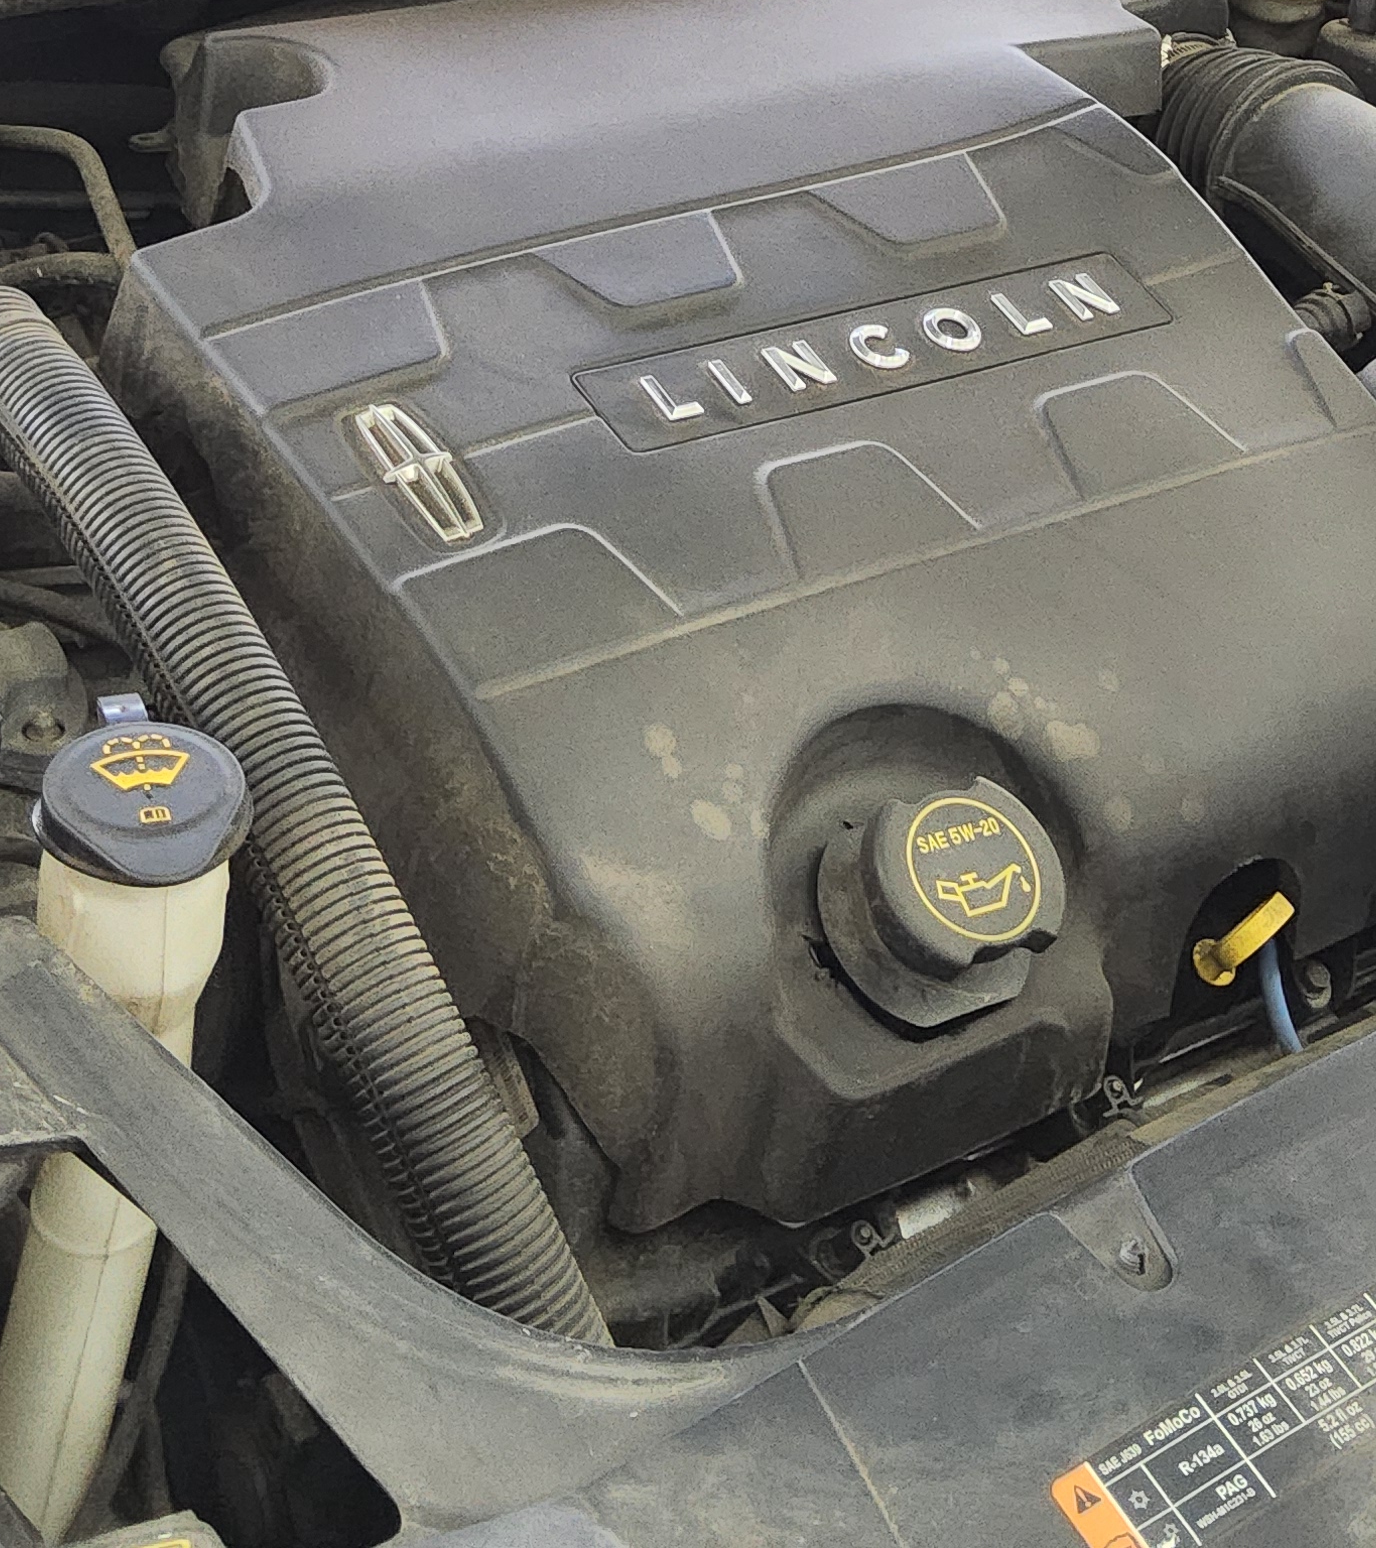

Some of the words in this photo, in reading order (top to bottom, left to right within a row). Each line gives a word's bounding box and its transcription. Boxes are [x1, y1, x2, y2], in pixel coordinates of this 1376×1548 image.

[639, 272, 1121, 422] LINCOLN
[916, 831, 950, 854] SAE
[948, 817, 1001, 845] 5W-20
[1341, 1333, 1373, 1357] 0.822
[1361, 1348, 1376, 1363] 29
[1285, 1368, 1317, 1391] 0.652
[1316, 1359, 1334, 1374] kg
[1305, 1383, 1320, 1398] 23
[1319, 1377, 1333, 1389] oz
[1227, 1400, 1258, 1426] 0.737
[1257, 1393, 1277, 1408] kg
[1311, 1394, 1332, 1412] 1.44
[1329, 1386, 1346, 1400] lbs
[1248, 1417, 1263, 1433] 26
[1262, 1412, 1276, 1423] oz
[1318, 1409, 1339, 1432] 5.2
[1346, 1401, 1363, 1414] oz
[1329, 1425, 1357, 1449] (155
[1355, 1413, 1376, 1430] cc)
[1097, 1457, 1122, 1475] SAE
[1120, 1443, 1143, 1463] J639
[1143, 1405, 1201, 1446] FoMoCo
[1252, 1429, 1273, 1447] 1.63
[1272, 1420, 1290, 1435] lbs
[1177, 1442, 1225, 1476] R-134a
[1215, 1474, 1248, 1500] PAG
